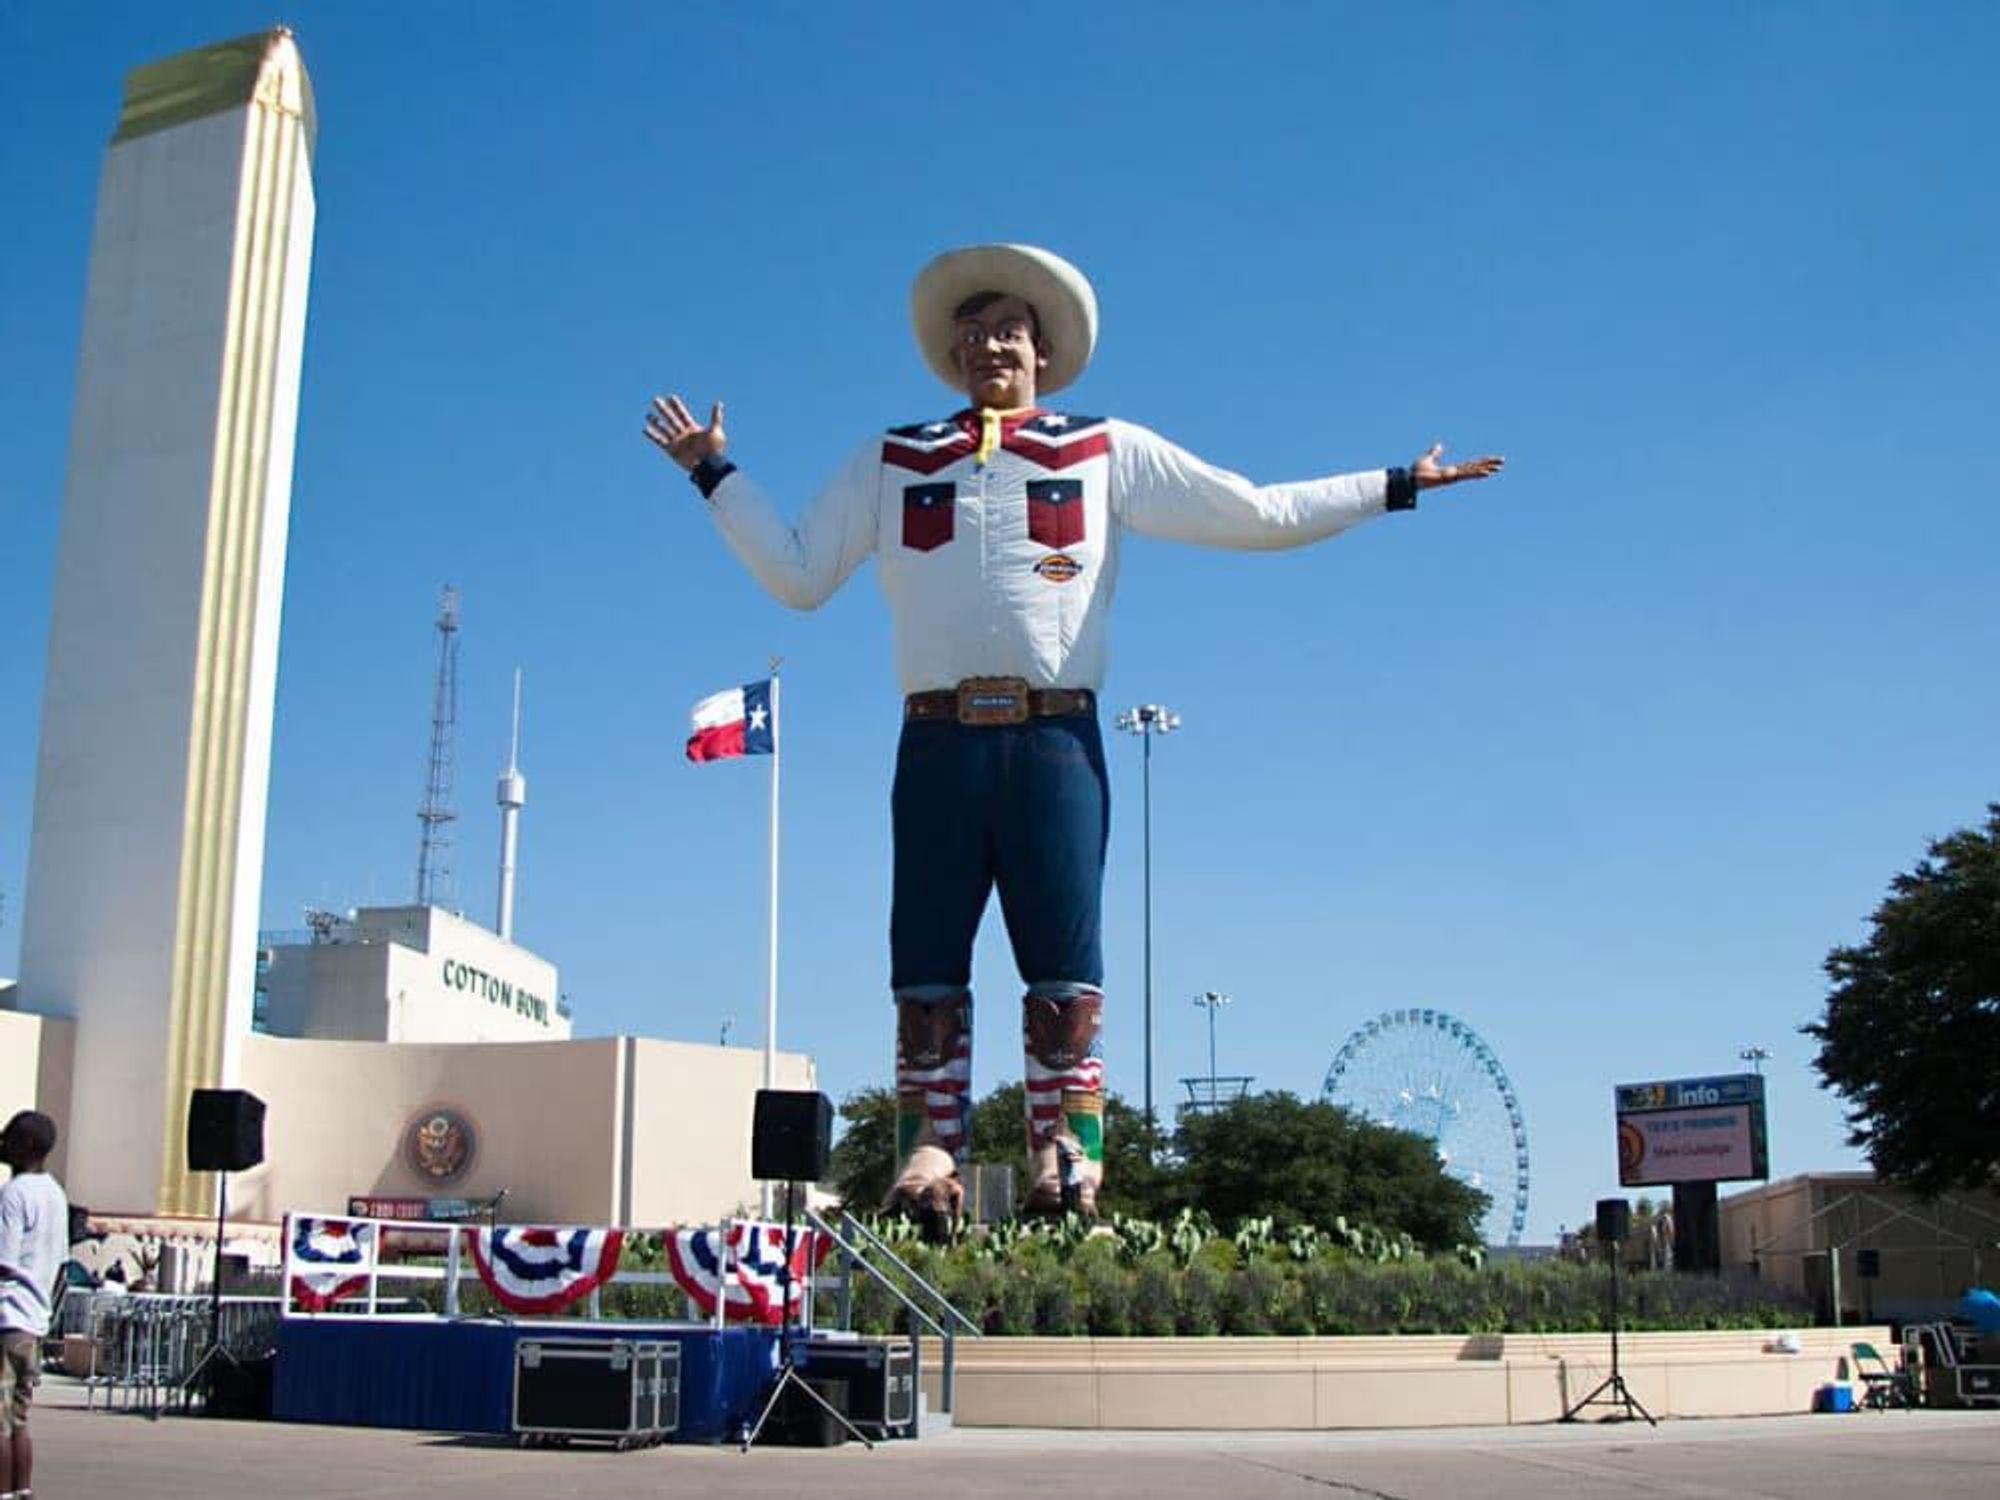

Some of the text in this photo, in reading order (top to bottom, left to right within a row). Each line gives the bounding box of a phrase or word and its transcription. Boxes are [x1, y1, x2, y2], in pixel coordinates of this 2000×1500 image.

[443, 959, 548, 1027] COTTON BOWL
[1678, 1084, 1719, 1105] info
